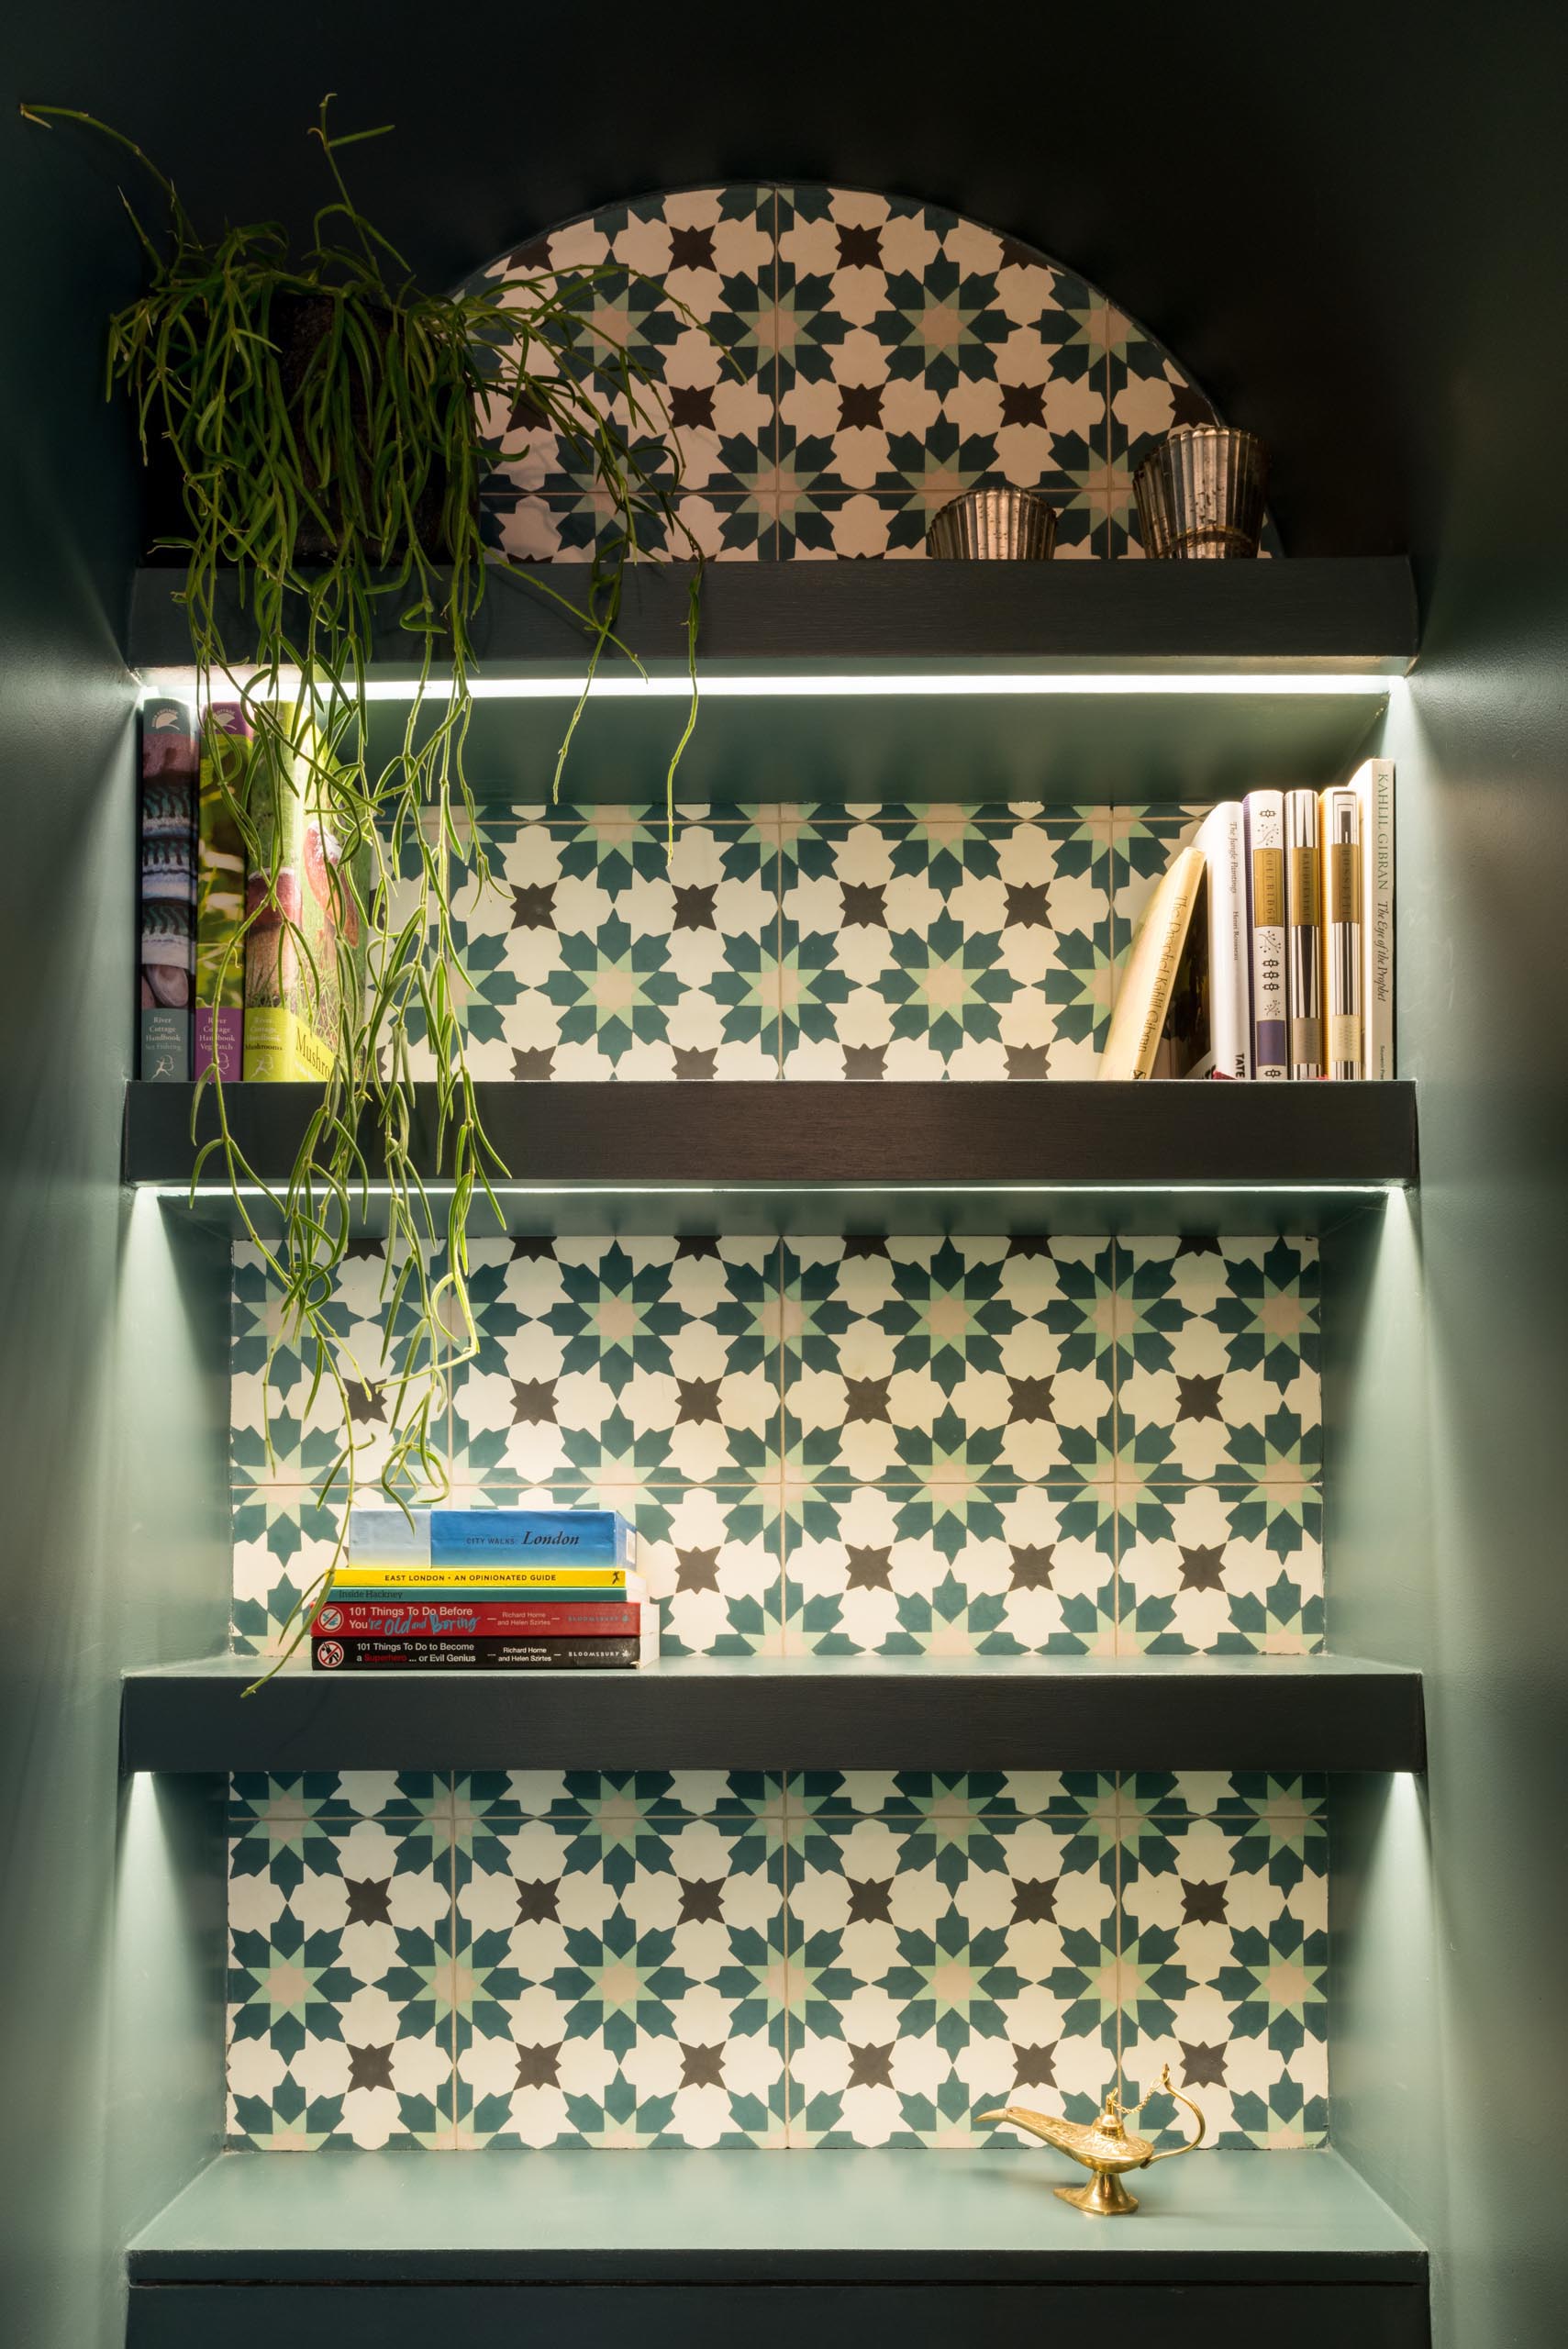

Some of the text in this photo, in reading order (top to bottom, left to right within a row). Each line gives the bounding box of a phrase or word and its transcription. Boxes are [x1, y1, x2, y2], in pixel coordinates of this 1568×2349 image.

[1378, 774, 1388, 890] KAHLIL GIBRAN
[1228, 838, 1238, 860] Jungle
[1230, 862, 1239, 894] Paintings
[1265, 852, 1276, 920] COLERIDGE
[1159, 896, 1187, 974] The Prophet
[1374, 901, 1389, 1002] The Eye of the Prophet
[1138, 977, 1167, 1052] Kahlil Gibran
[149, 1026, 176, 1034] Cottage
[203, 1026, 230, 1034] Coage
[1235, 1053, 1245, 1077] TATE
[521, 1531, 580, 1545] London
[339, 1590, 403, 1599] Inside Hackney
[350, 1607, 473, 1618] 101 Things To Do Before
[373, 1643, 402, 1652] Things
[364, 1654, 407, 1664] Superhero
